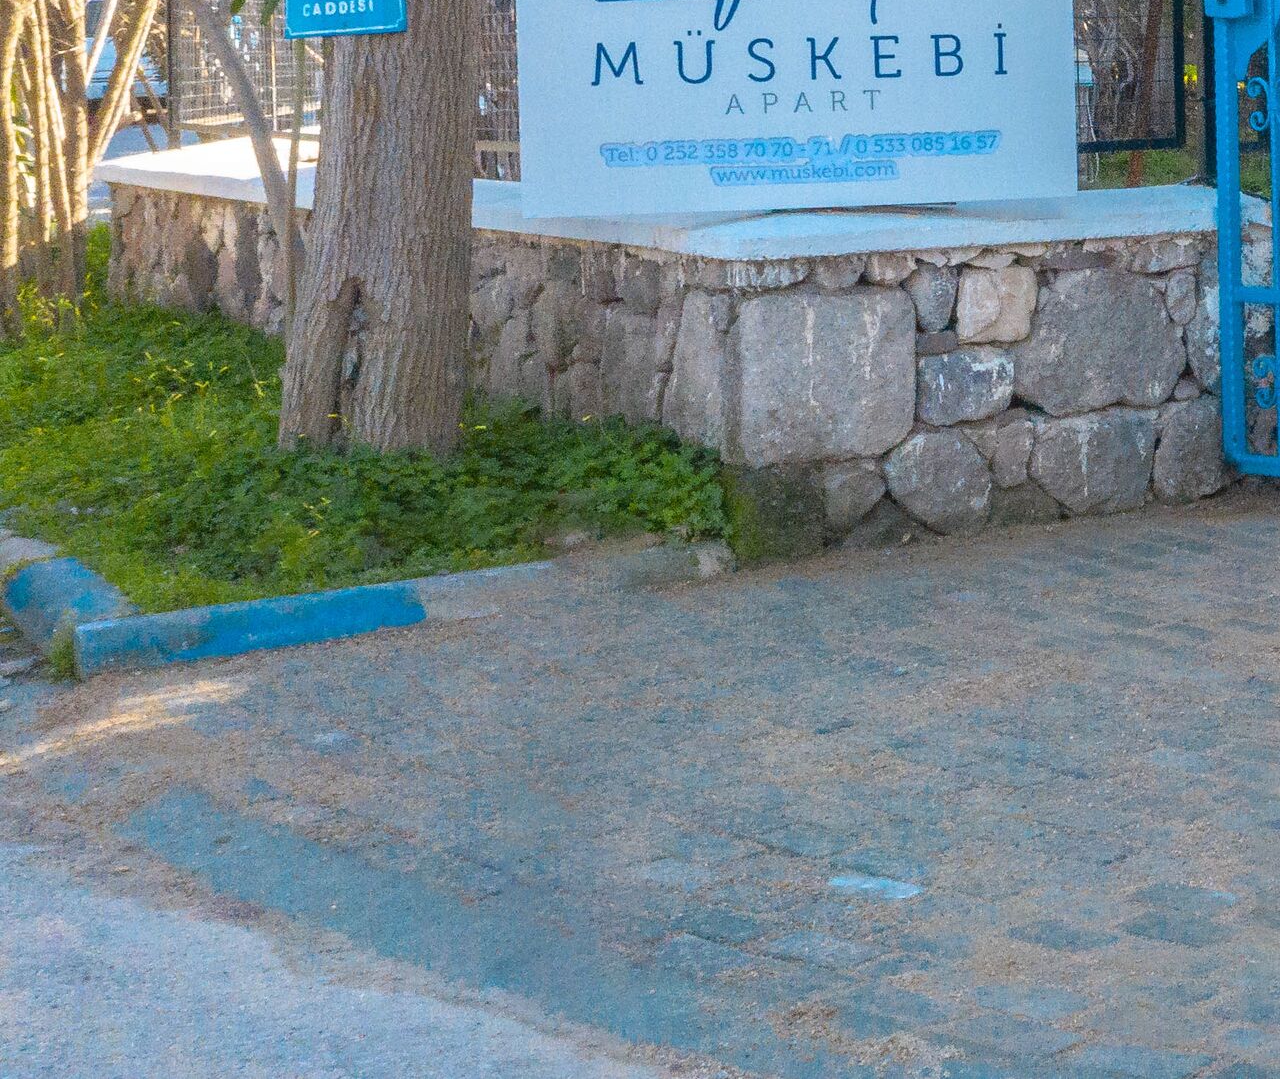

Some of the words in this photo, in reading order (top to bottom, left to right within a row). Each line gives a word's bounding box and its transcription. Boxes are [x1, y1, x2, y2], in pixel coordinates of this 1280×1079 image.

[591, 23, 1008, 86] MÜSKEBİ
[725, 89, 881, 115] APART
[606, 146, 640, 163] Tel:
[646, 146, 657, 161] 0
[664, 145, 698, 160] 252
[744, 142, 766, 157] 70
[772, 141, 794, 158] 70
[855, 138, 867, 154] 0
[873, 137, 906, 153] 533
[911, 135, 945, 152] 085
[951, 134, 972, 151] 16
[976, 133, 998, 149] 57
[716, 160, 895, 184] www.muskebi.com
